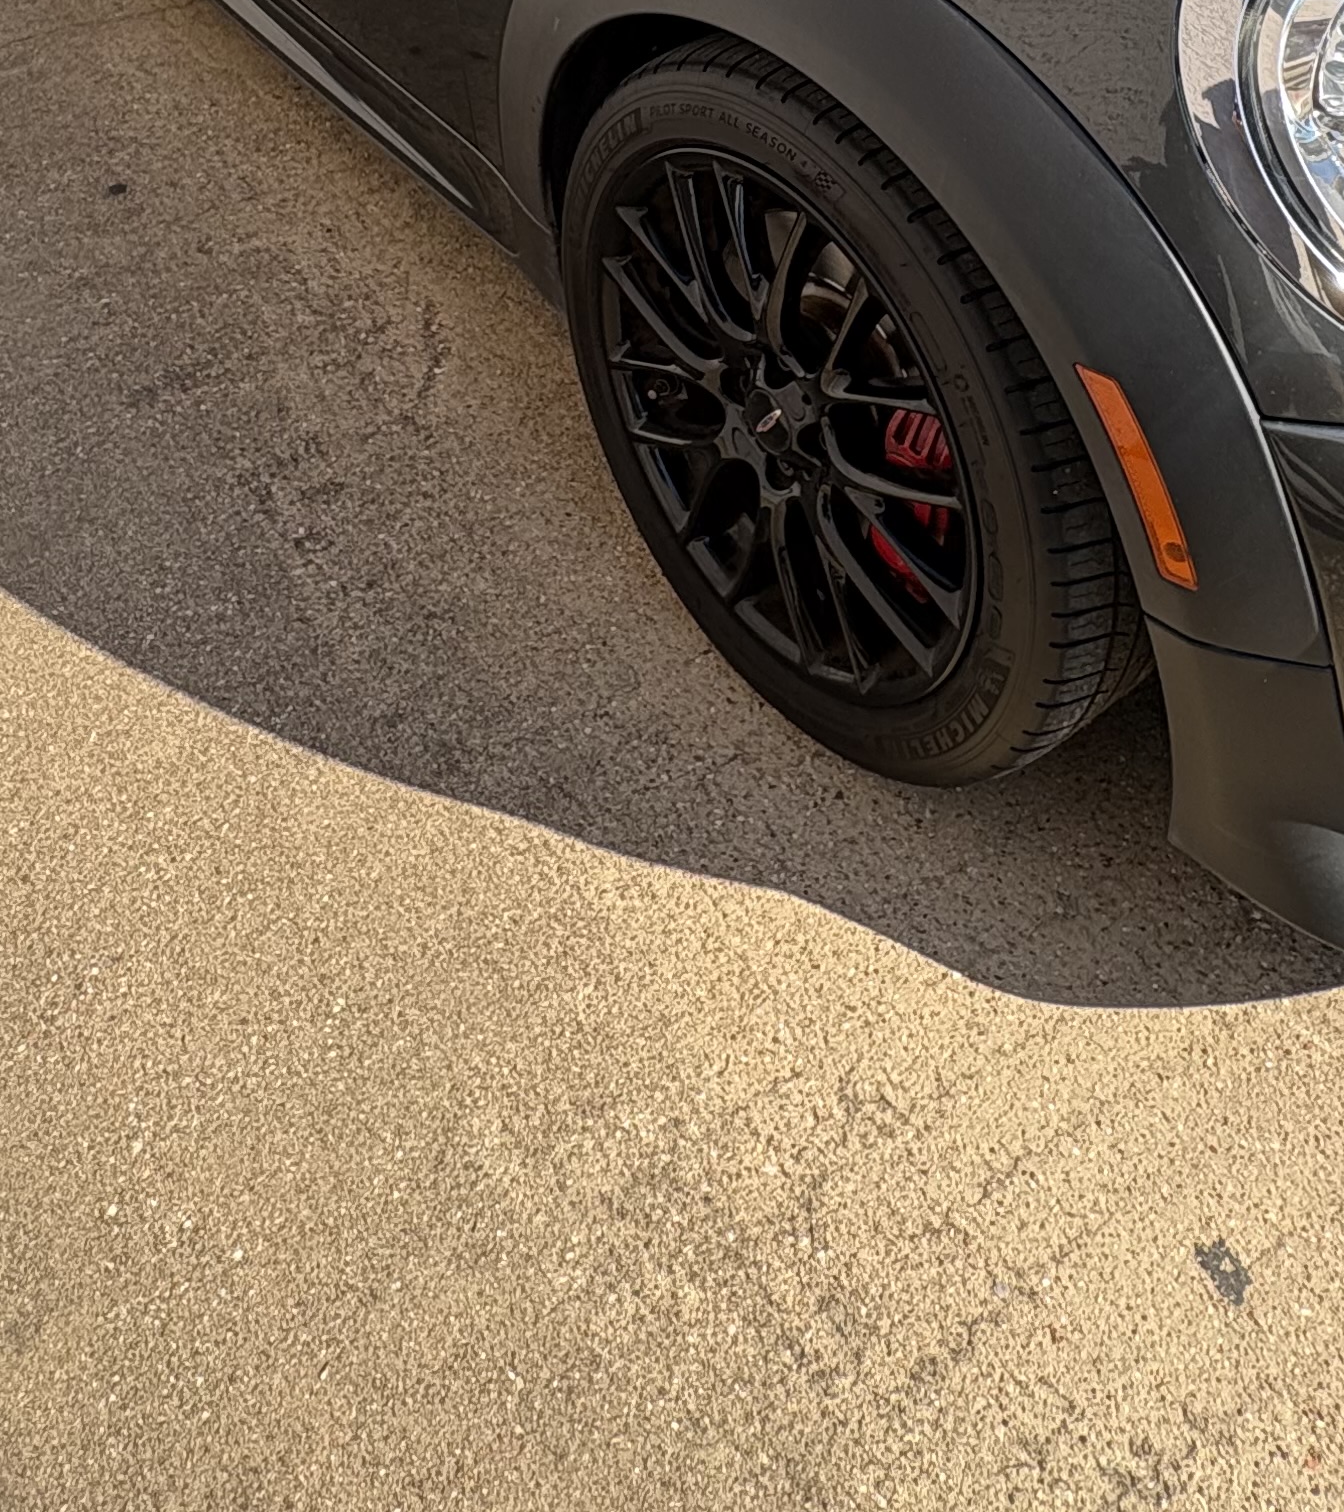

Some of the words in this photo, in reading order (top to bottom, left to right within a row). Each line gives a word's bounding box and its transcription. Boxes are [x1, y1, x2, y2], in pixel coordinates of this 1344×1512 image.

[650, 103, 675, 118] PILOT
[679, 103, 715, 120] SPORT
[718, 112, 741, 129] ALL
[746, 122, 798, 162] SEASON
